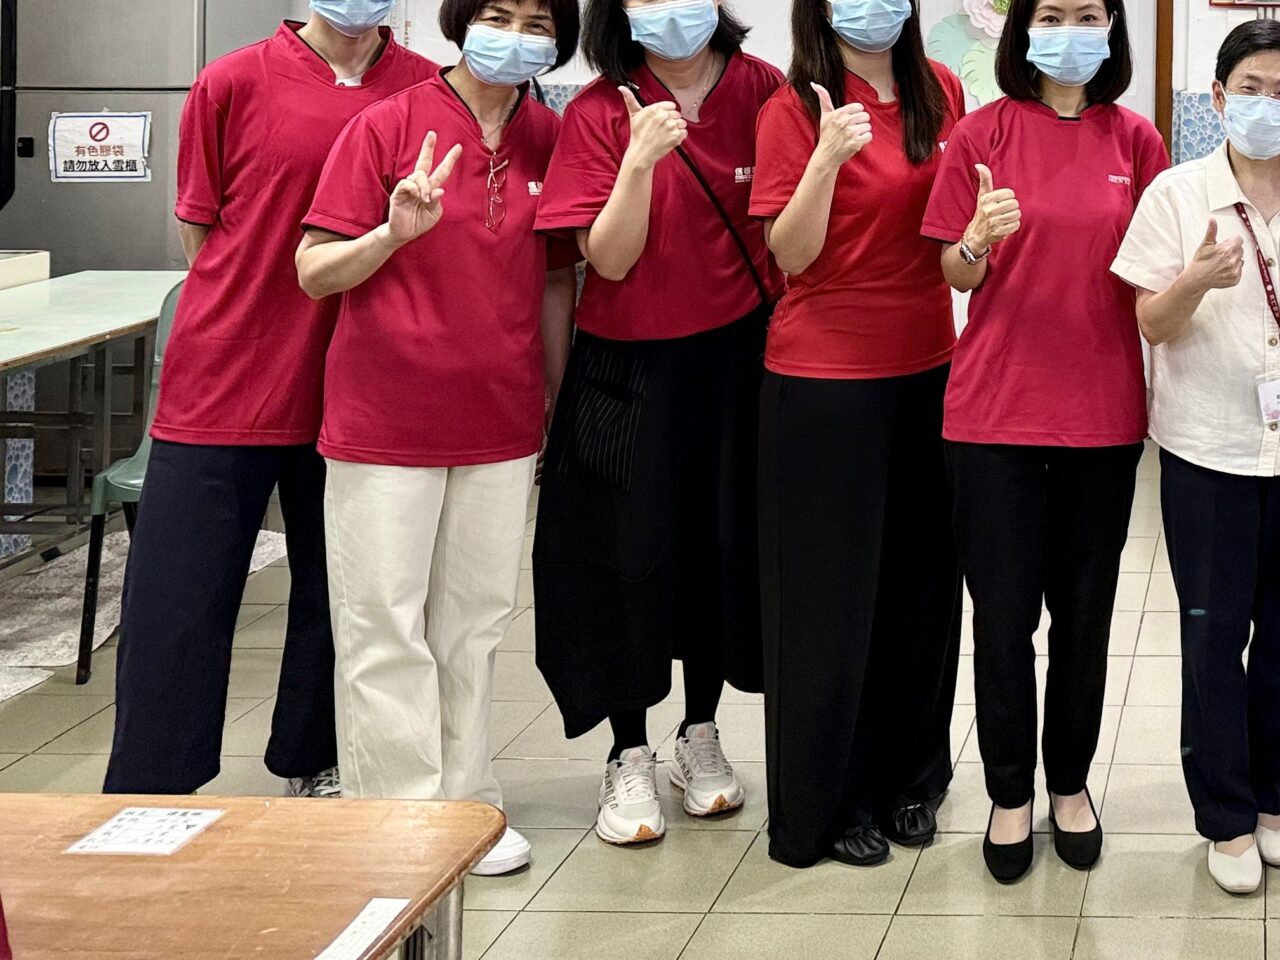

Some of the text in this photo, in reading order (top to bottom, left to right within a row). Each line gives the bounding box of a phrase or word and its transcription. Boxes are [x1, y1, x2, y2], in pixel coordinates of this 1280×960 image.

[74, 145, 125, 157] 有色膠袋
[63, 160, 137, 172] 請勿放入雪櫃
